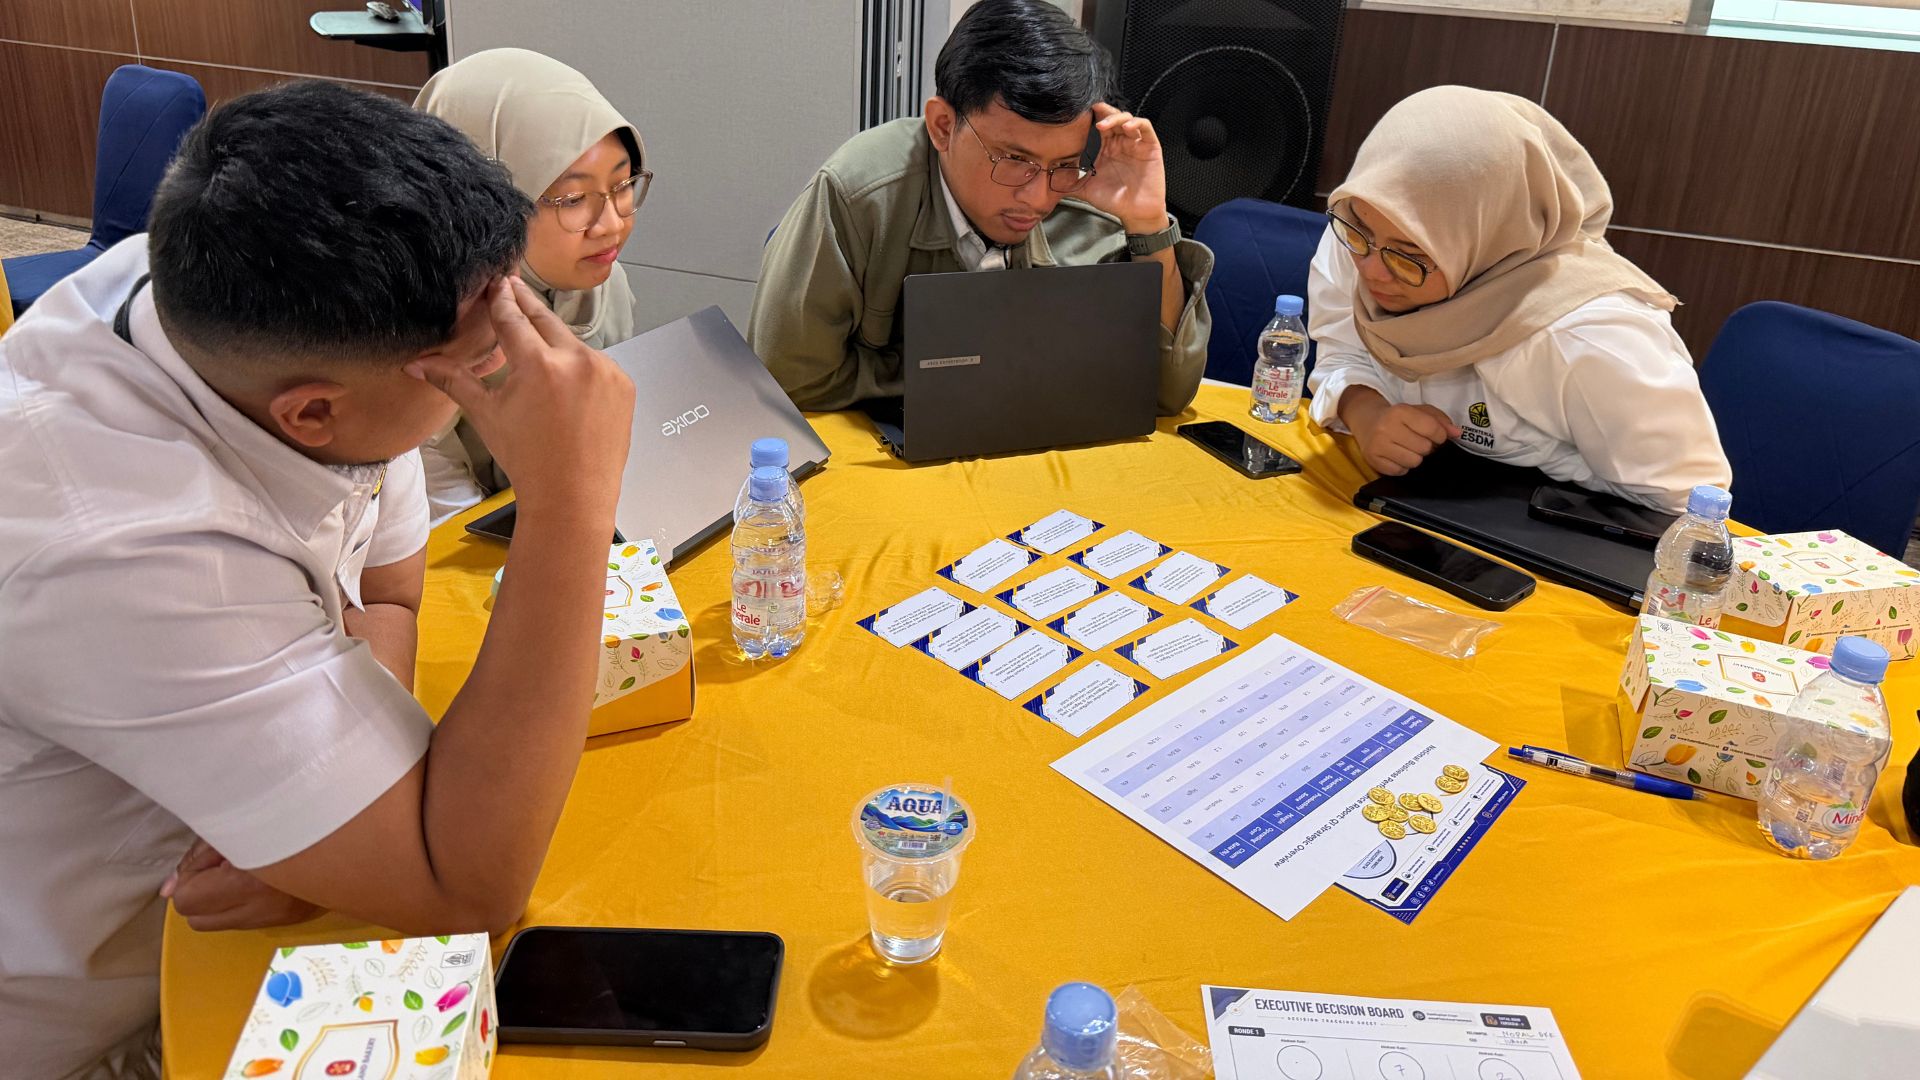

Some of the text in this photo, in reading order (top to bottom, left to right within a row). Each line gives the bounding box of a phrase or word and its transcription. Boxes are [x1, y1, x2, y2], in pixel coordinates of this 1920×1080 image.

[1461, 431, 1495, 449] ESDM
[737, 598, 747, 612] Le
[733, 609, 761, 626] nerale
[1699, 615, 1712, 626] Le
[1319, 775, 1344, 792] Marketing
[886, 797, 942, 816] AQUA
[1271, 743, 1437, 869] National Business Perfonce Report: Q1 Strategic Overview
[1293, 791, 1323, 812] Productivity
[1275, 811, 1295, 825] Margin
[1247, 825, 1275, 844] Operating Cost
[1225, 840, 1241, 851] Rate
[1227, 846, 1246, 860] Churn
[1254, 998, 1404, 1019] EXECUTIVE DECISION BOARD
[1233, 1027, 1254, 1035] RONDE
[1394, 1064, 1406, 1076] 7
